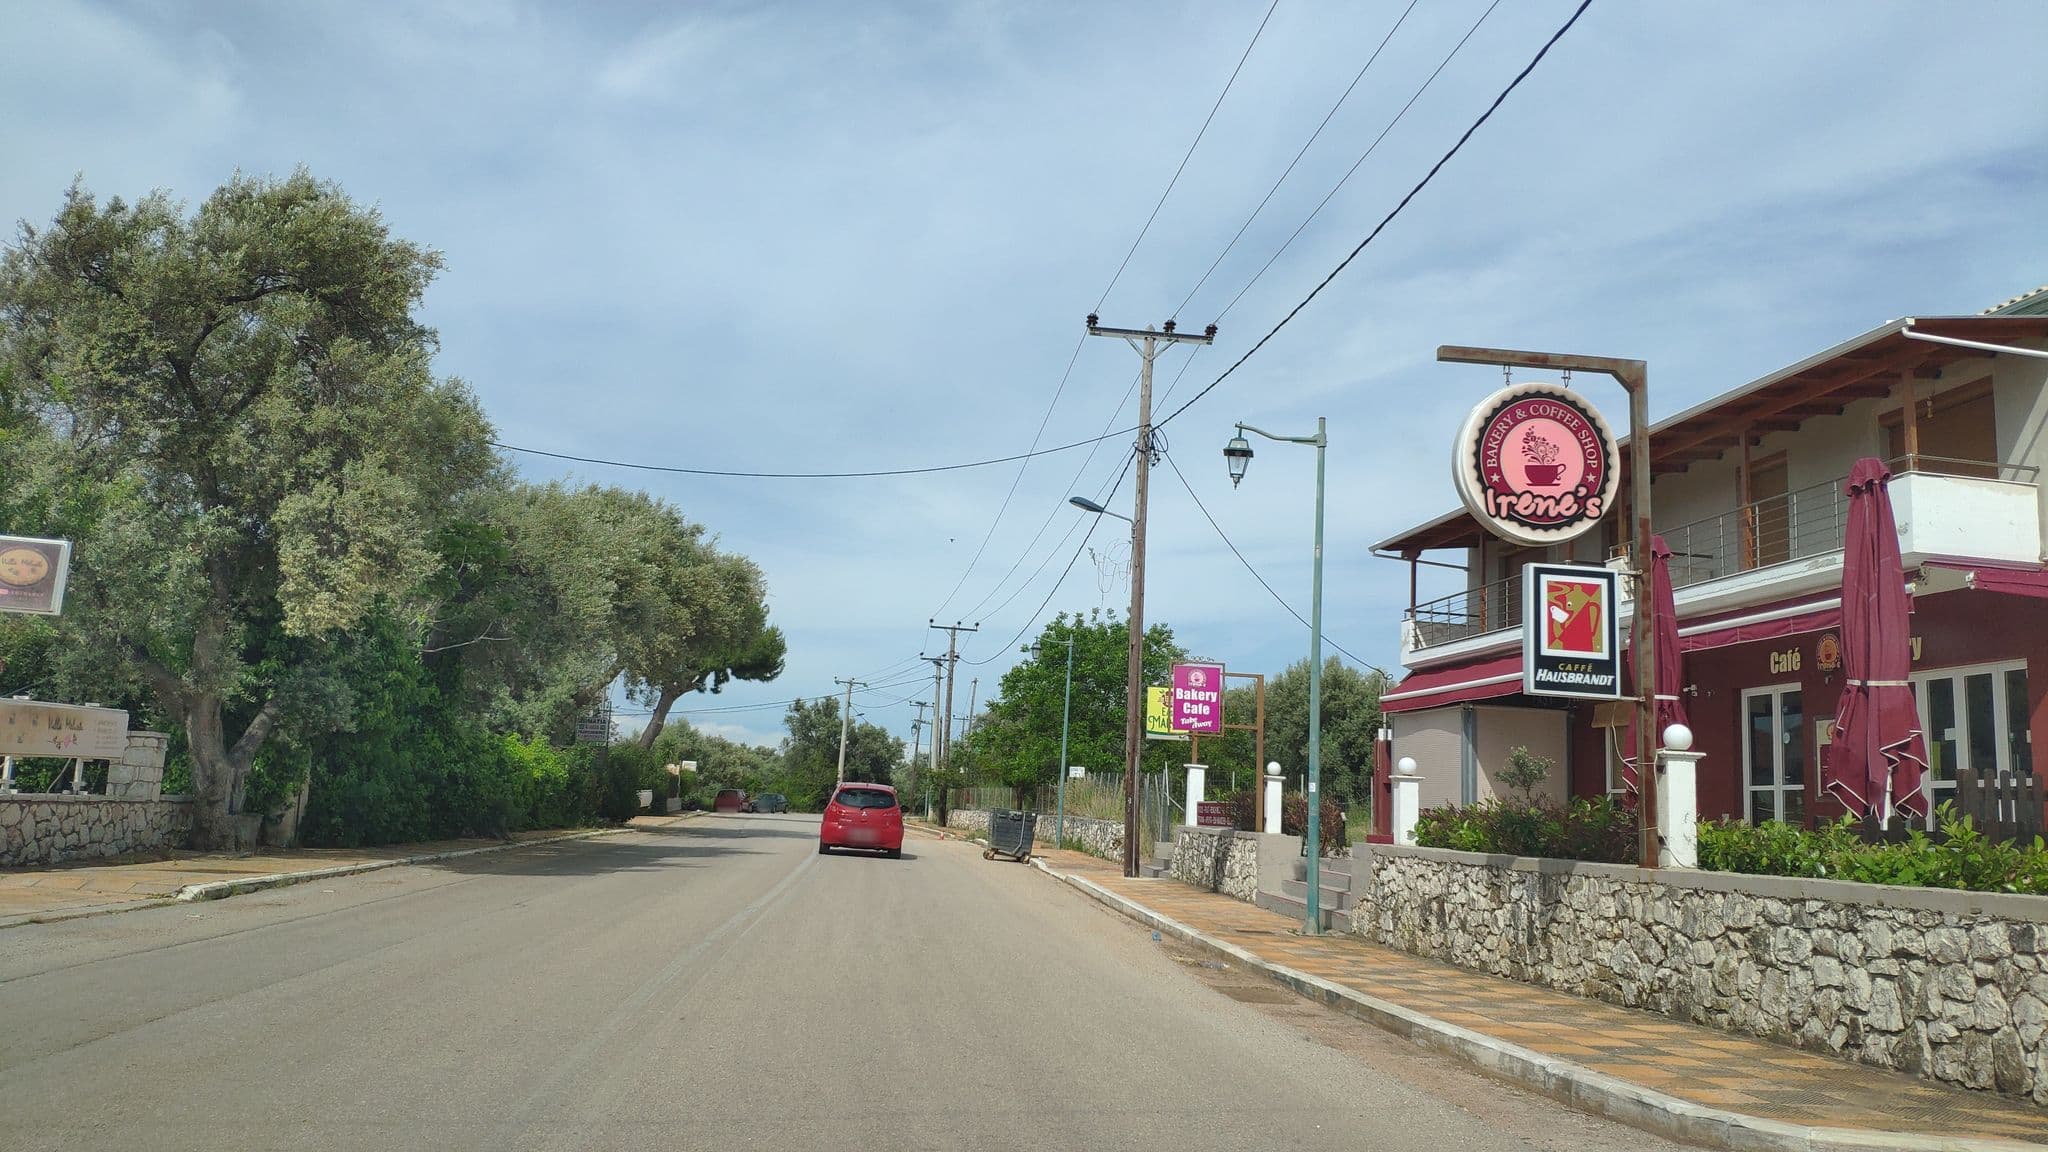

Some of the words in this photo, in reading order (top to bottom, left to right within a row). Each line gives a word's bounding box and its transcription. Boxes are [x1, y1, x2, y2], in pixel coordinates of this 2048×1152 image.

[1487, 414, 1516, 468] BAKERY
[1515, 408, 1528, 420] &
[1529, 404, 1582, 431] COFFEE
[1578, 429, 1598, 469] SHOP
[1485, 486, 1603, 519] Irene's
[1770, 647, 1801, 675] Café
[1535, 668, 1615, 686] HAUSBRANDT
[1175, 688, 1218, 703] Bakery
[1183, 702, 1211, 716] Cafe
